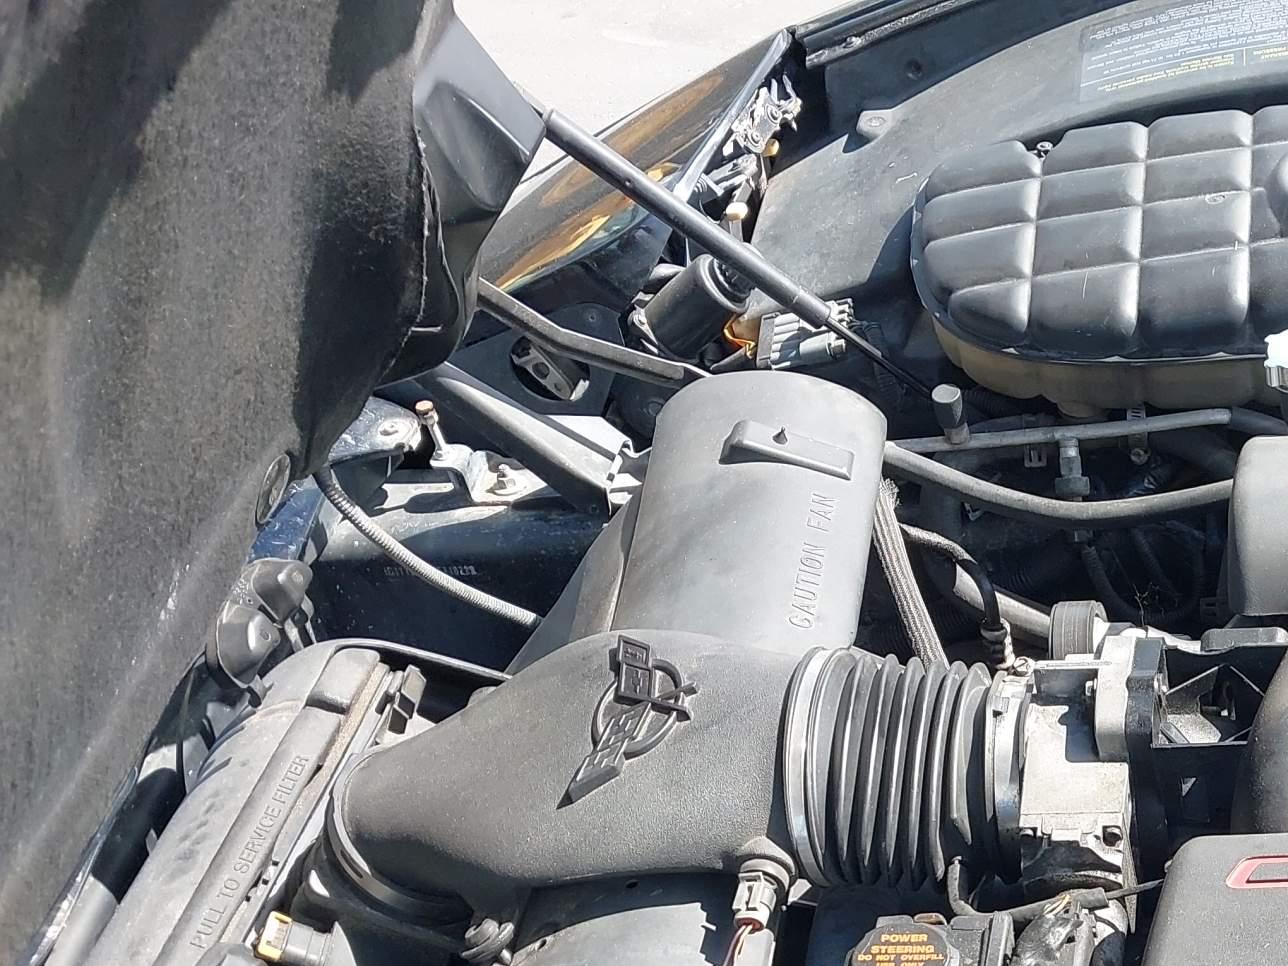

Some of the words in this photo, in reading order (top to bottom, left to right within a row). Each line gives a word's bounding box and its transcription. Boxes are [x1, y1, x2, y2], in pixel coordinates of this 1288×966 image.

[806, 492, 835, 533] FAN
[788, 541, 825, 629] CAUTION
[189, 906, 227, 950] PULL
[216, 876, 241, 900] TO
[233, 804, 282, 875] SERVICE
[271, 755, 310, 804] FILTER
[870, 945, 935, 955] STEERING
[880, 933, 929, 943] POWER
[900, 953, 945, 961] OVERFILL
